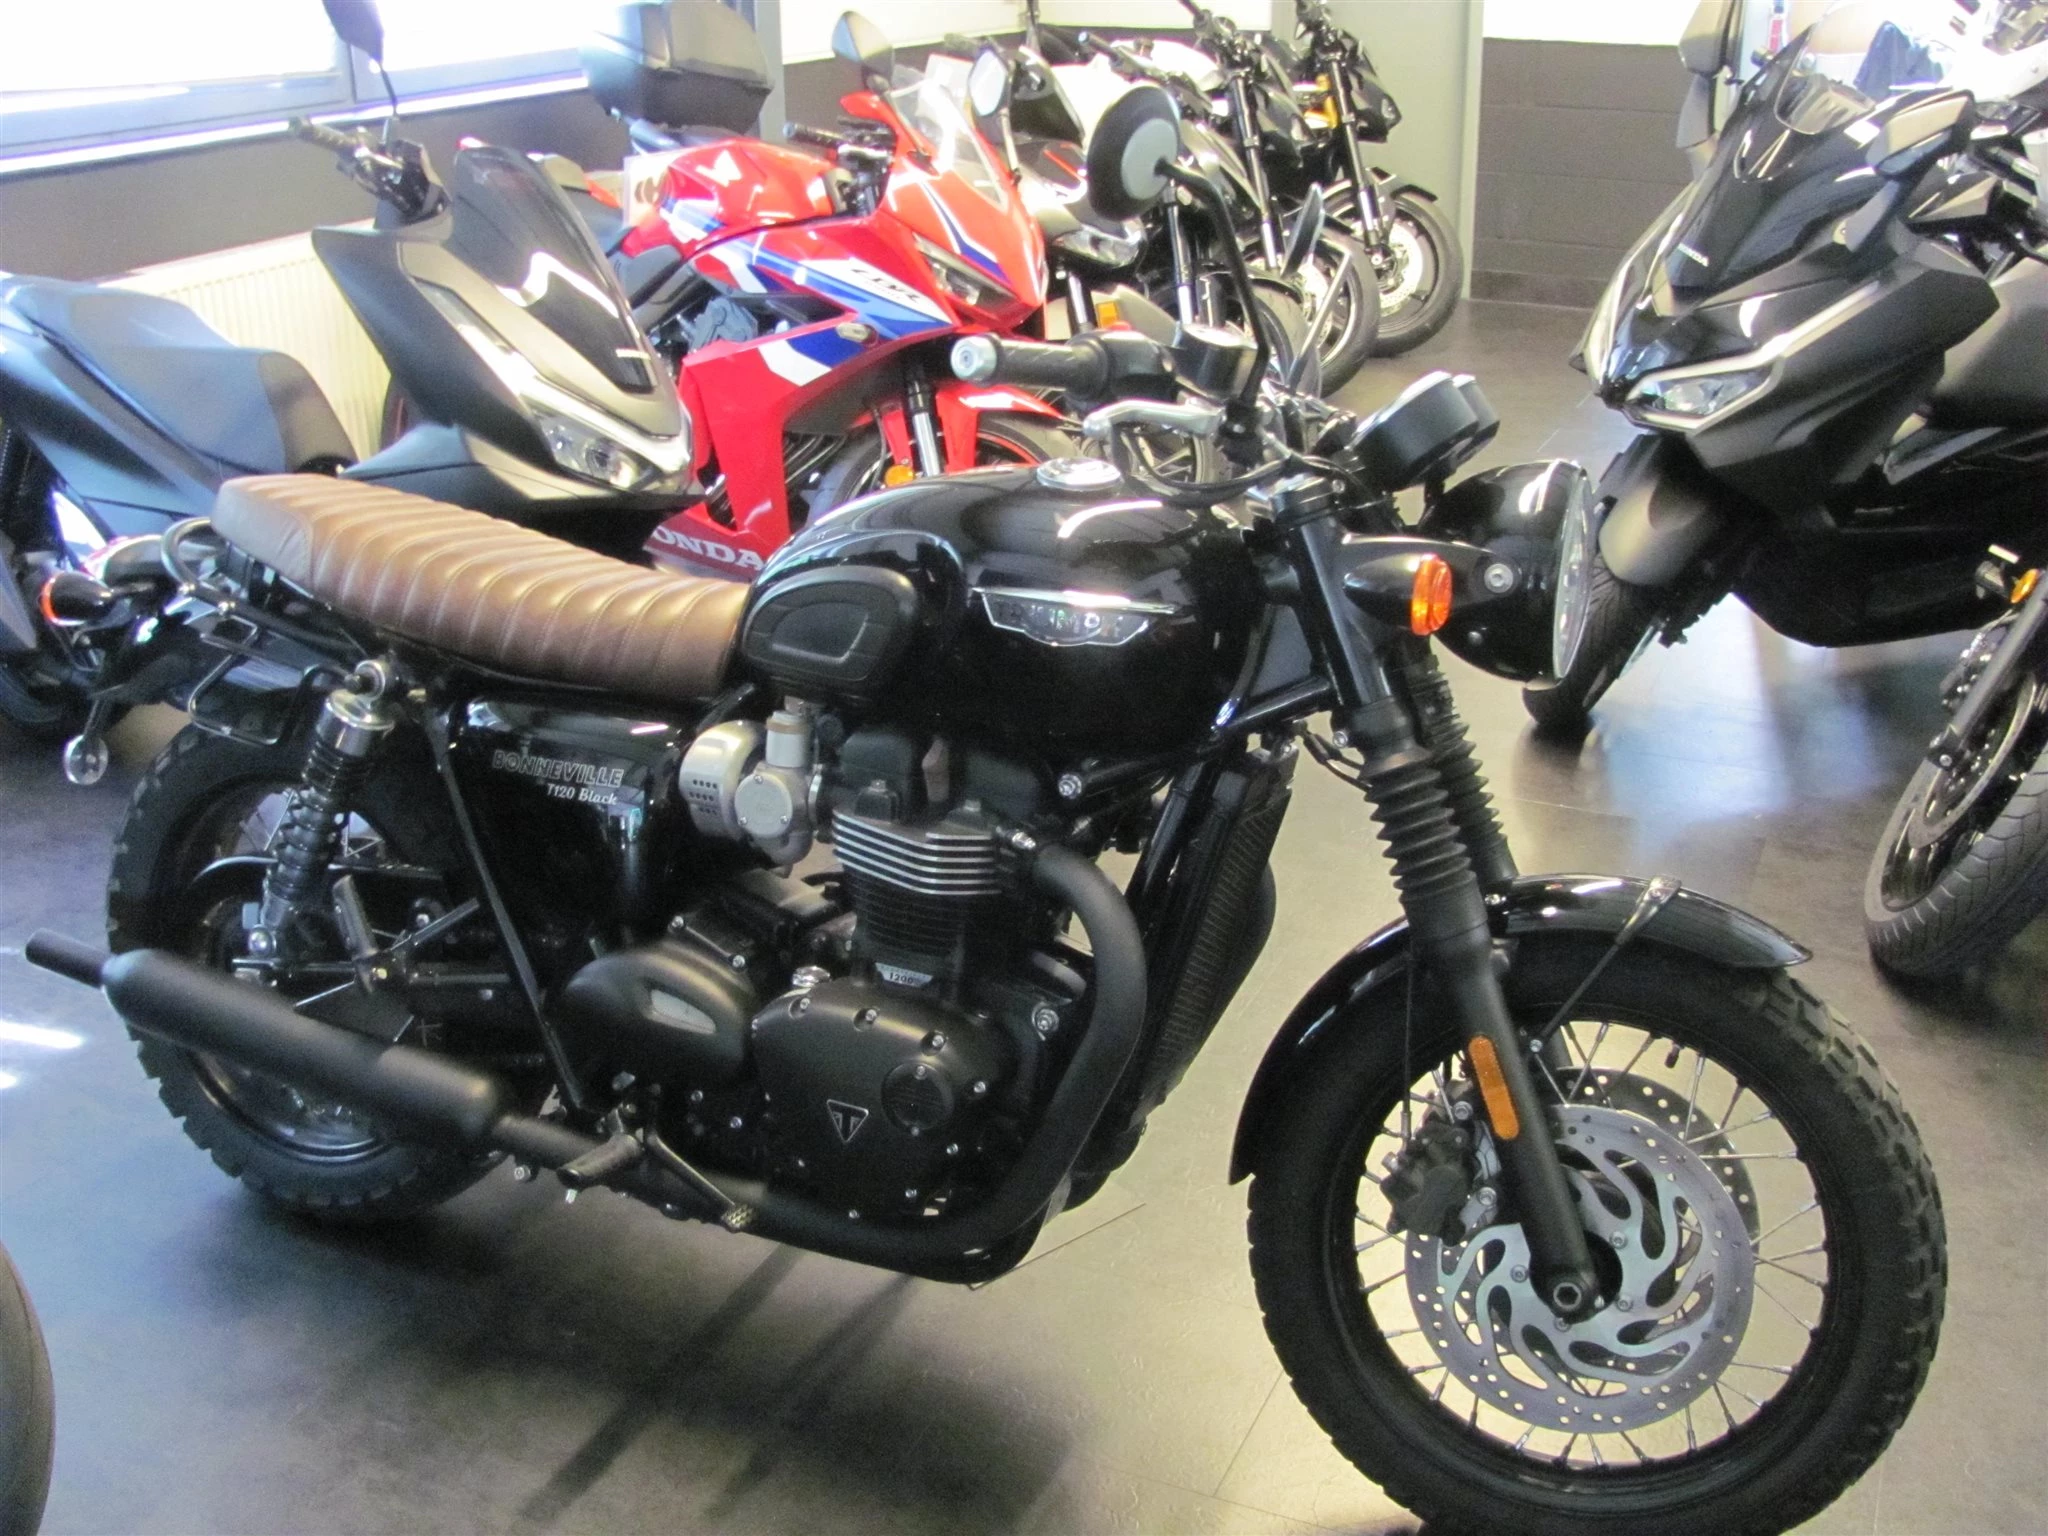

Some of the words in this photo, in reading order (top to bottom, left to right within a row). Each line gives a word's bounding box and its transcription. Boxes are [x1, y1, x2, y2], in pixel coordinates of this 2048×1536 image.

[650, 525, 765, 571] ONDA
[492, 750, 625, 788] BONNEVILLE
[547, 783, 575, 801] T120
[578, 787, 619, 806] Black
[889, 972, 914, 985] 1200
